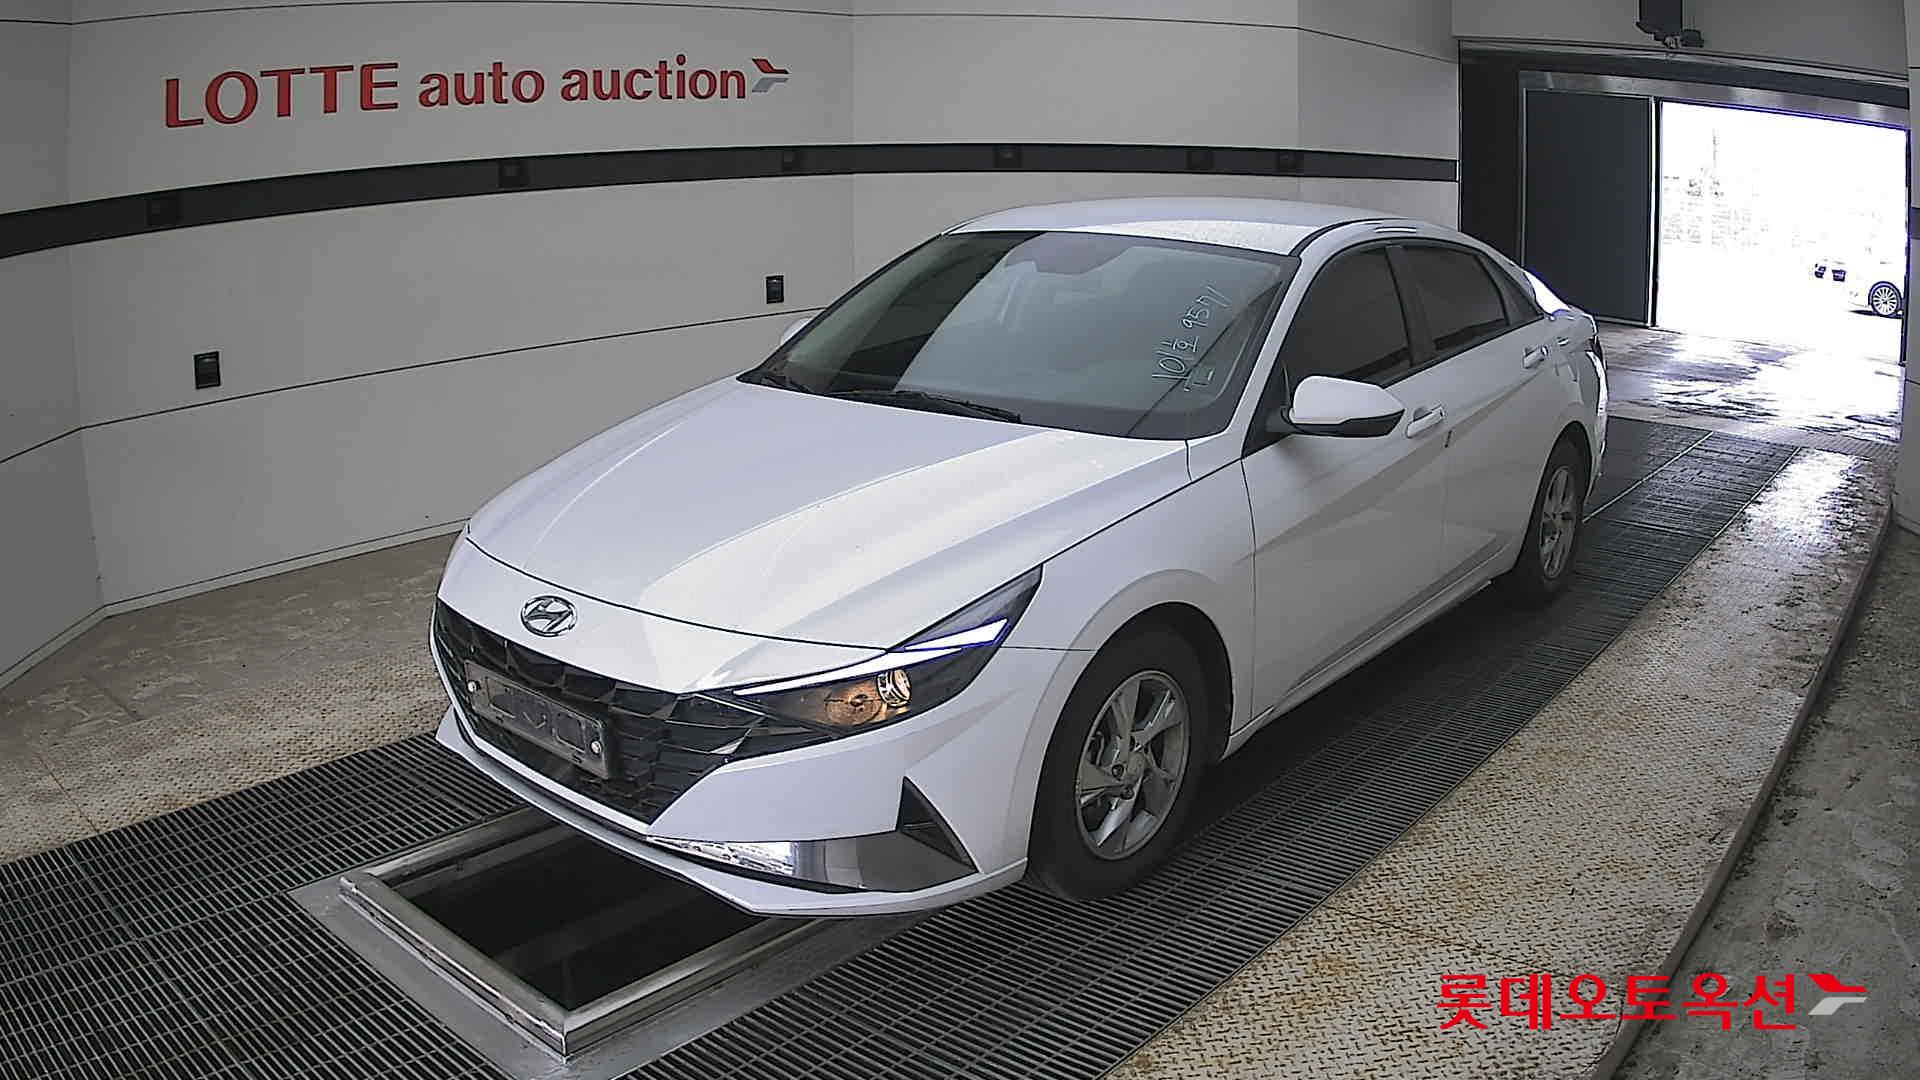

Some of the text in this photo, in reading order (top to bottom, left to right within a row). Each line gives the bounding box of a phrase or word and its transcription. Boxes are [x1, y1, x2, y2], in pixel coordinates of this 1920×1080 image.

[165, 53, 746, 128] LOTTE auto auction
